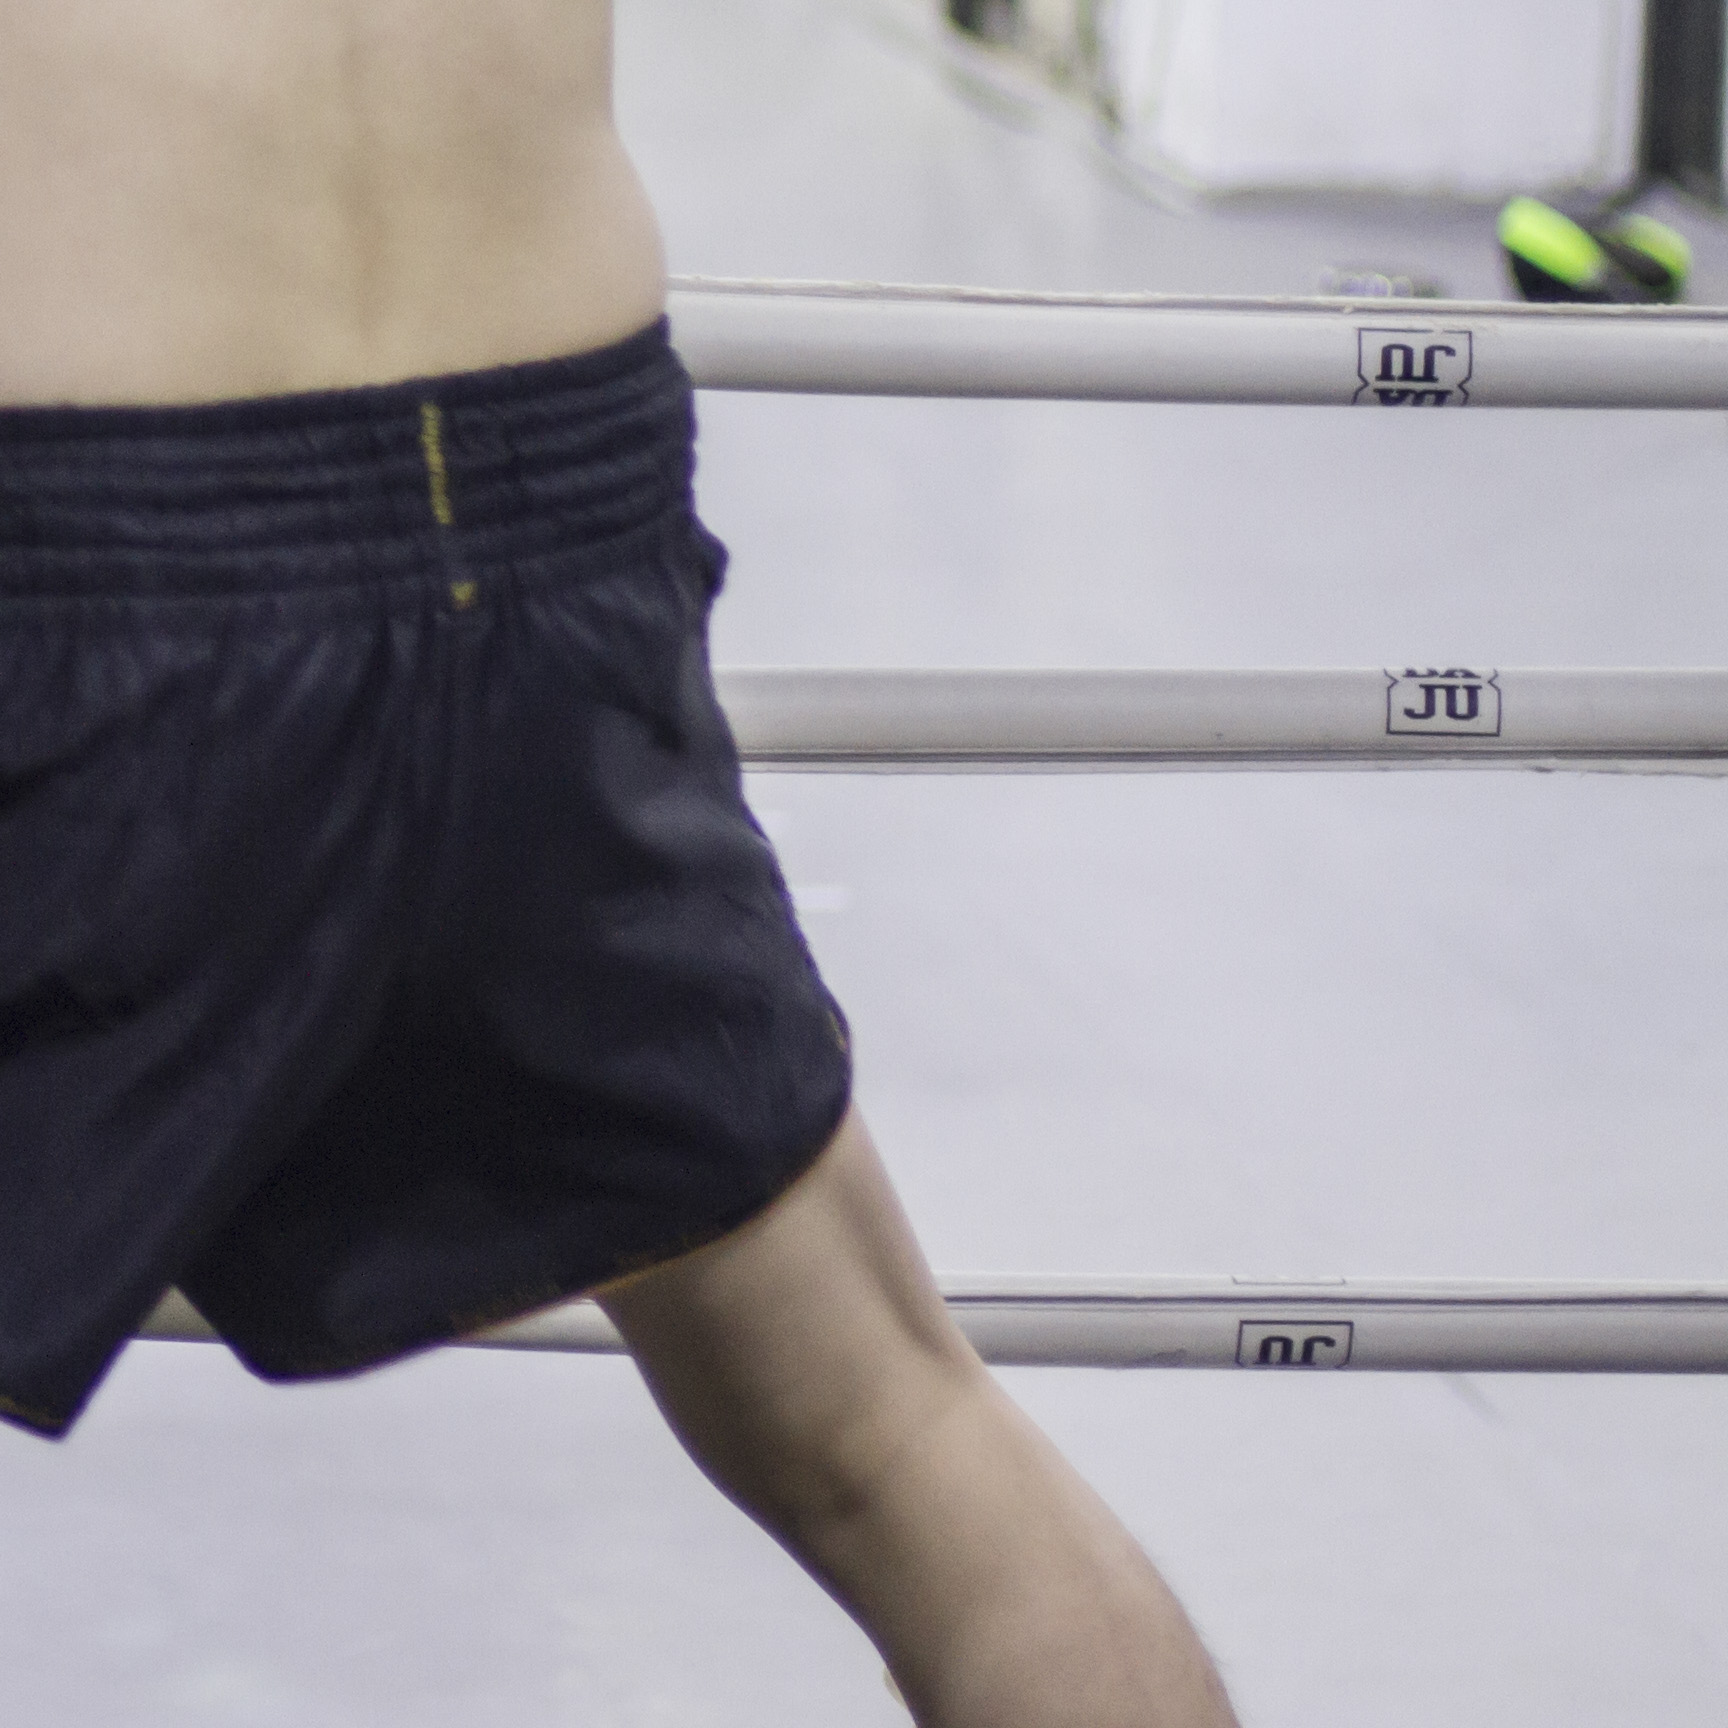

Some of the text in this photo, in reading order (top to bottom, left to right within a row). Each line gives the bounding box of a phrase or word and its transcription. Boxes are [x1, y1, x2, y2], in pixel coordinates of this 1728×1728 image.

[1375, 343, 1456, 382] JU
[1403, 684, 1482, 720] JU
[1252, 1335, 1336, 1365] JU
